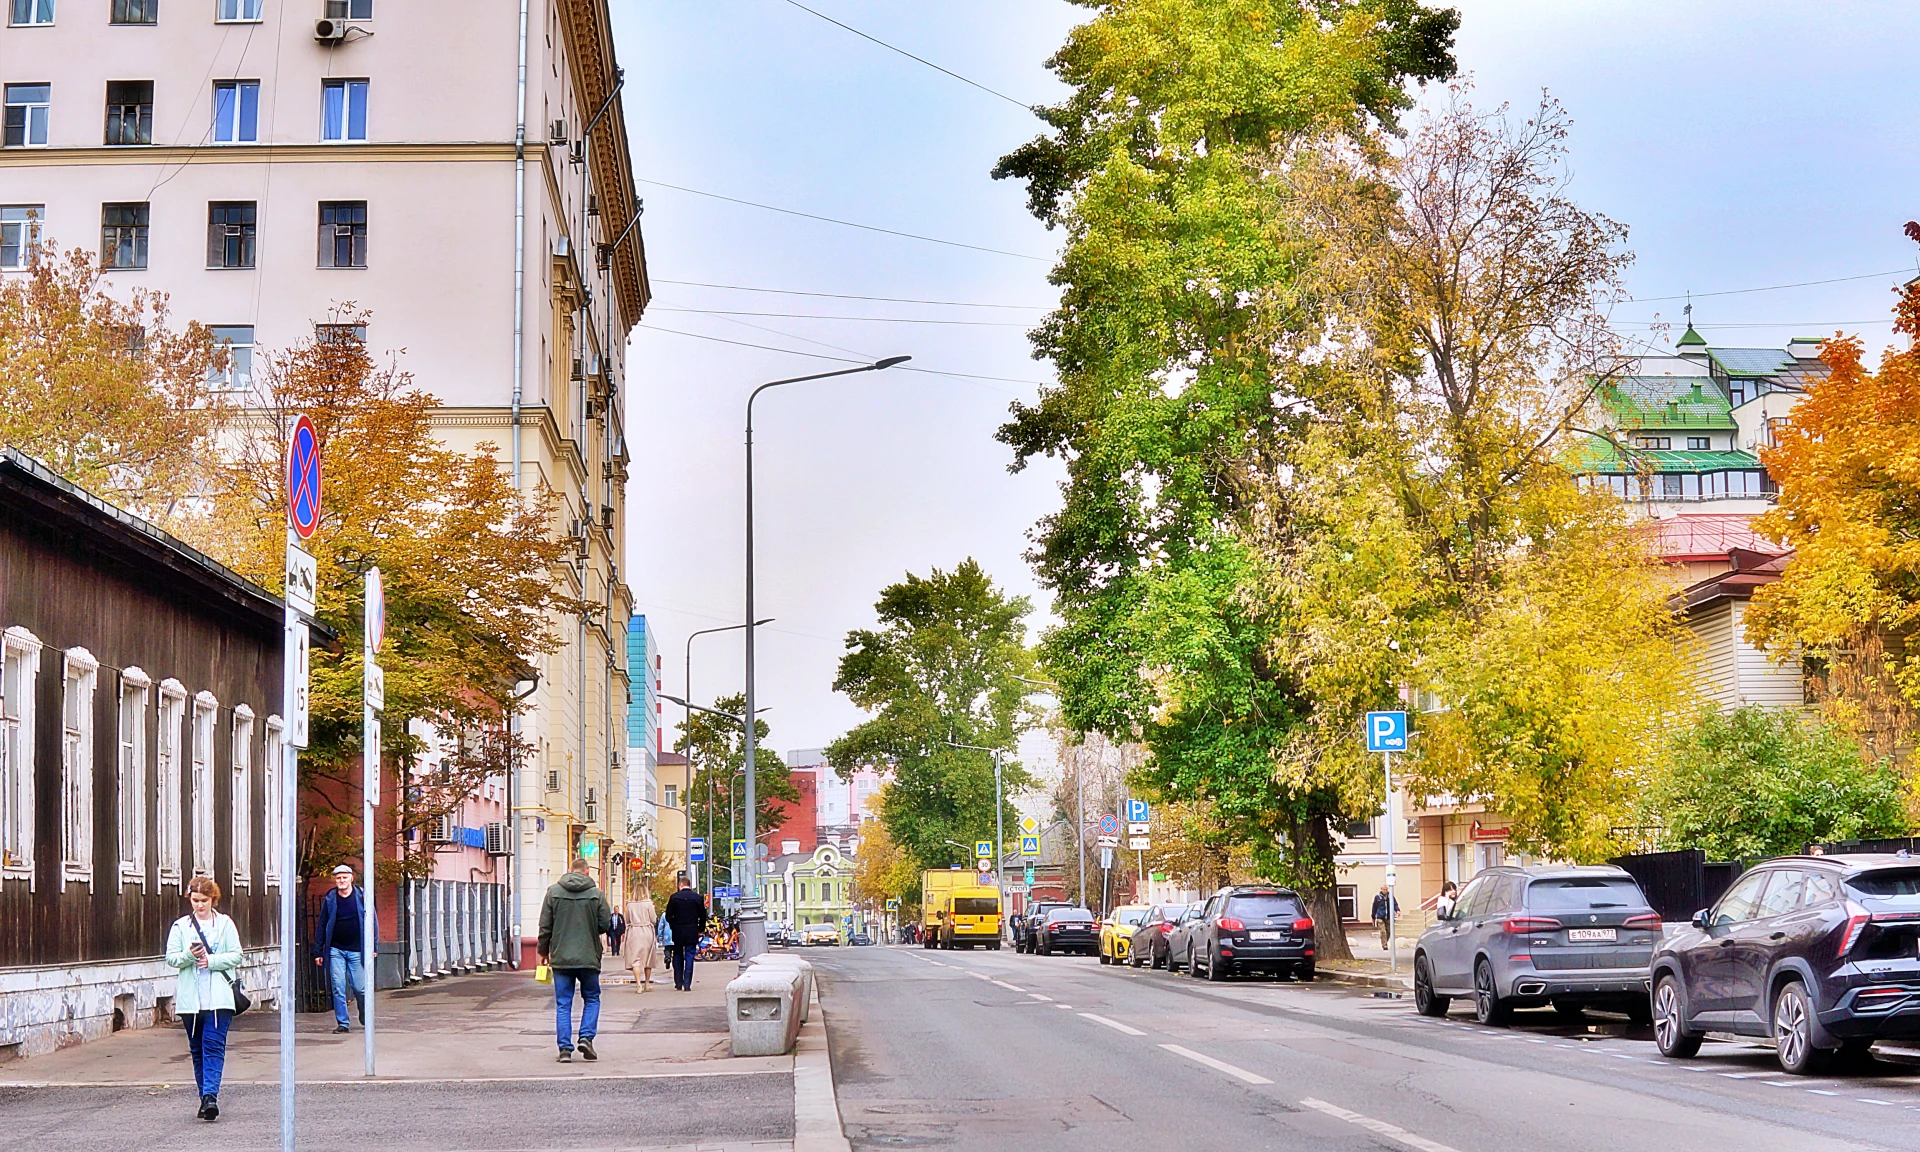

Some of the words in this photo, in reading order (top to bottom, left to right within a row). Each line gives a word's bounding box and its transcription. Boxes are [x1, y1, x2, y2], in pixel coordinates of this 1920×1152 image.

[297, 687, 304, 711] 15
[1373, 716, 1396, 747] P
[1132, 800, 1145, 820] P
